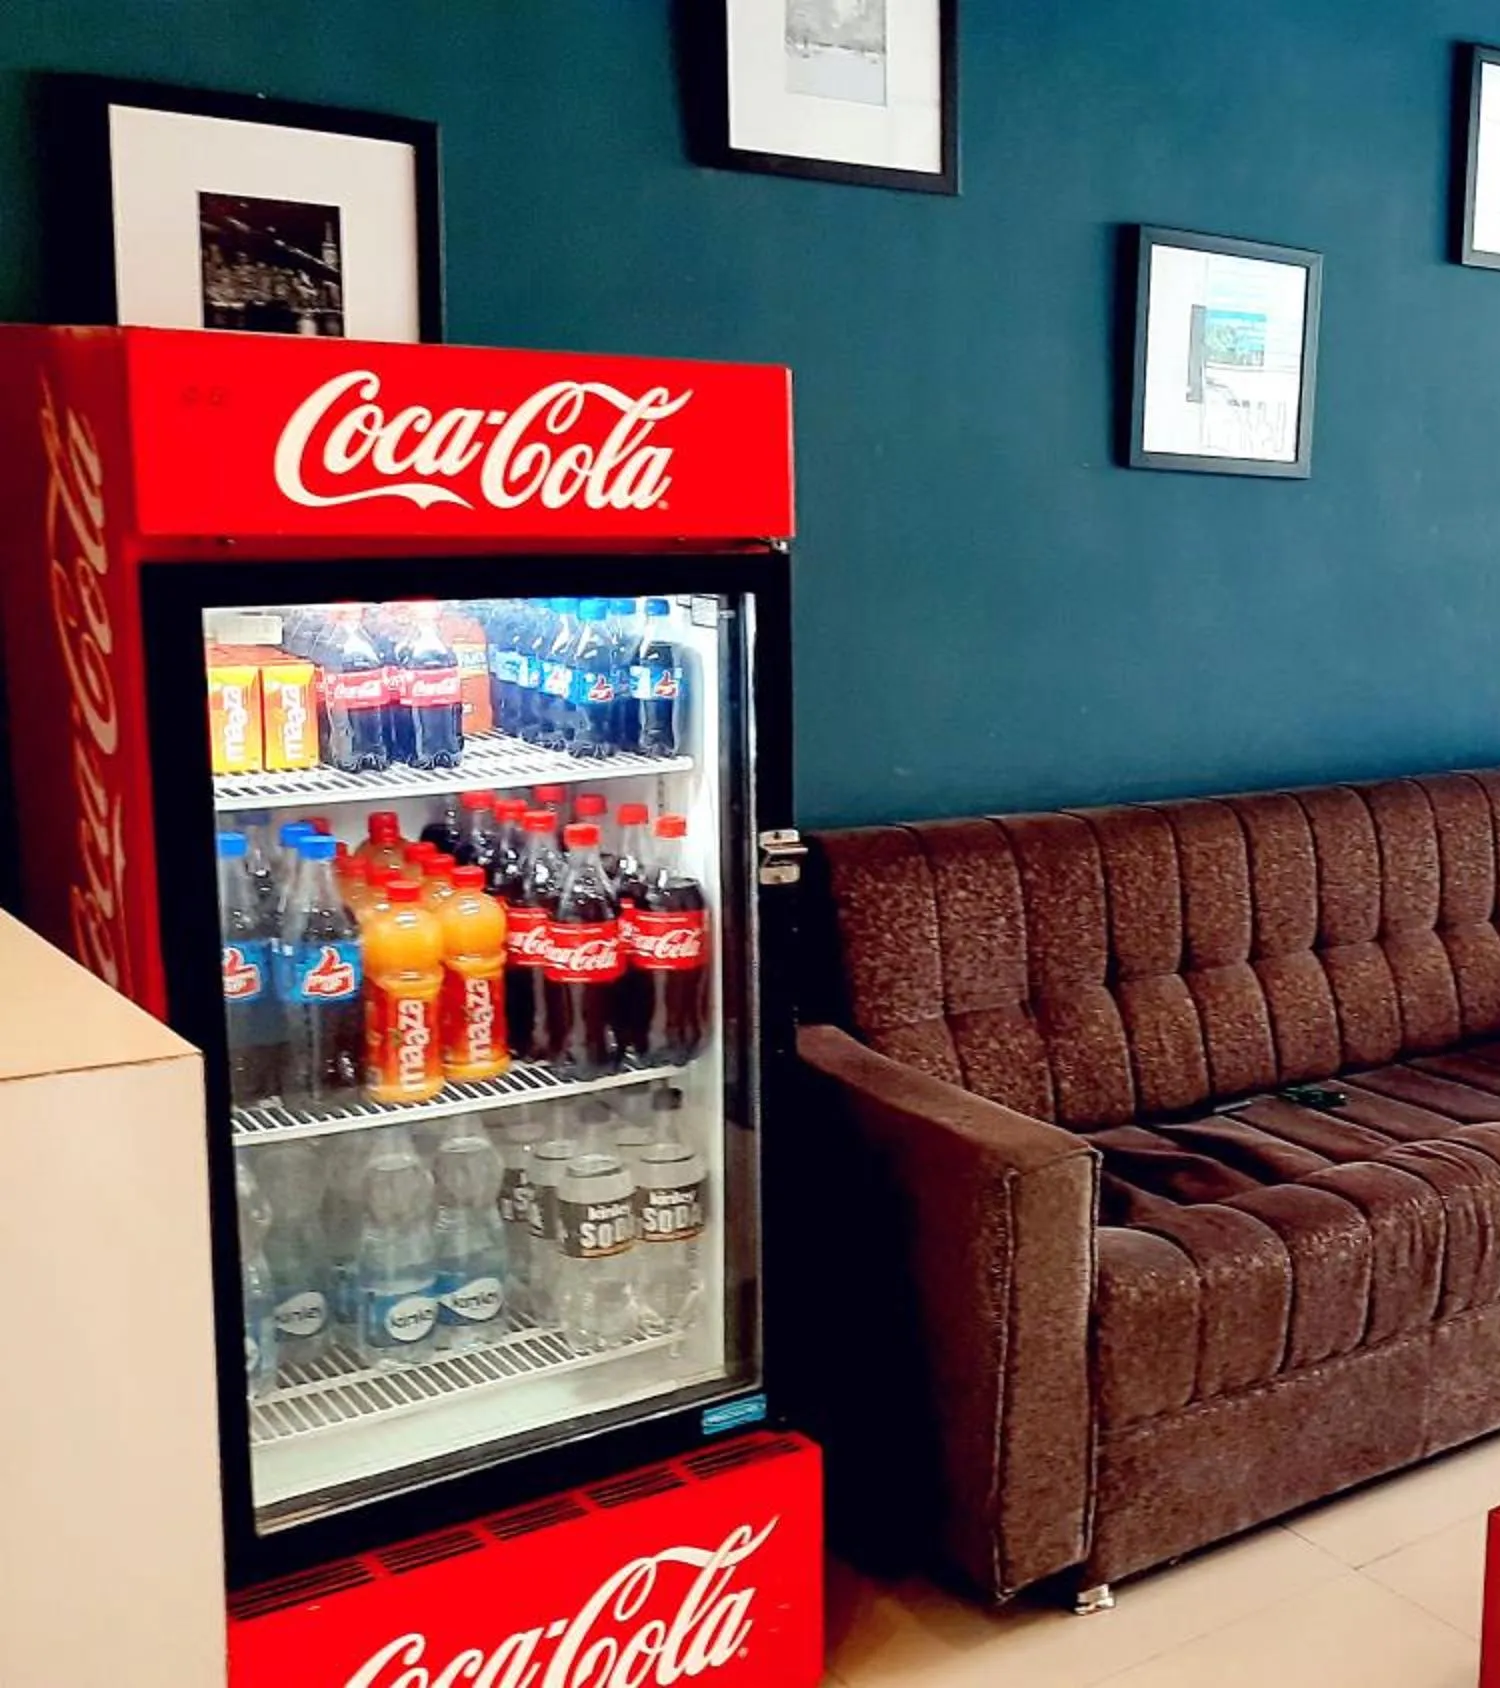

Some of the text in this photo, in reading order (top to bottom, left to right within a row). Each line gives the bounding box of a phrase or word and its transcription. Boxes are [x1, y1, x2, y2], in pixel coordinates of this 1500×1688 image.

[274, 370, 693, 510] Coca-Cola
[398, 999, 430, 1093] maaza
[465, 978, 494, 1064] maaza
